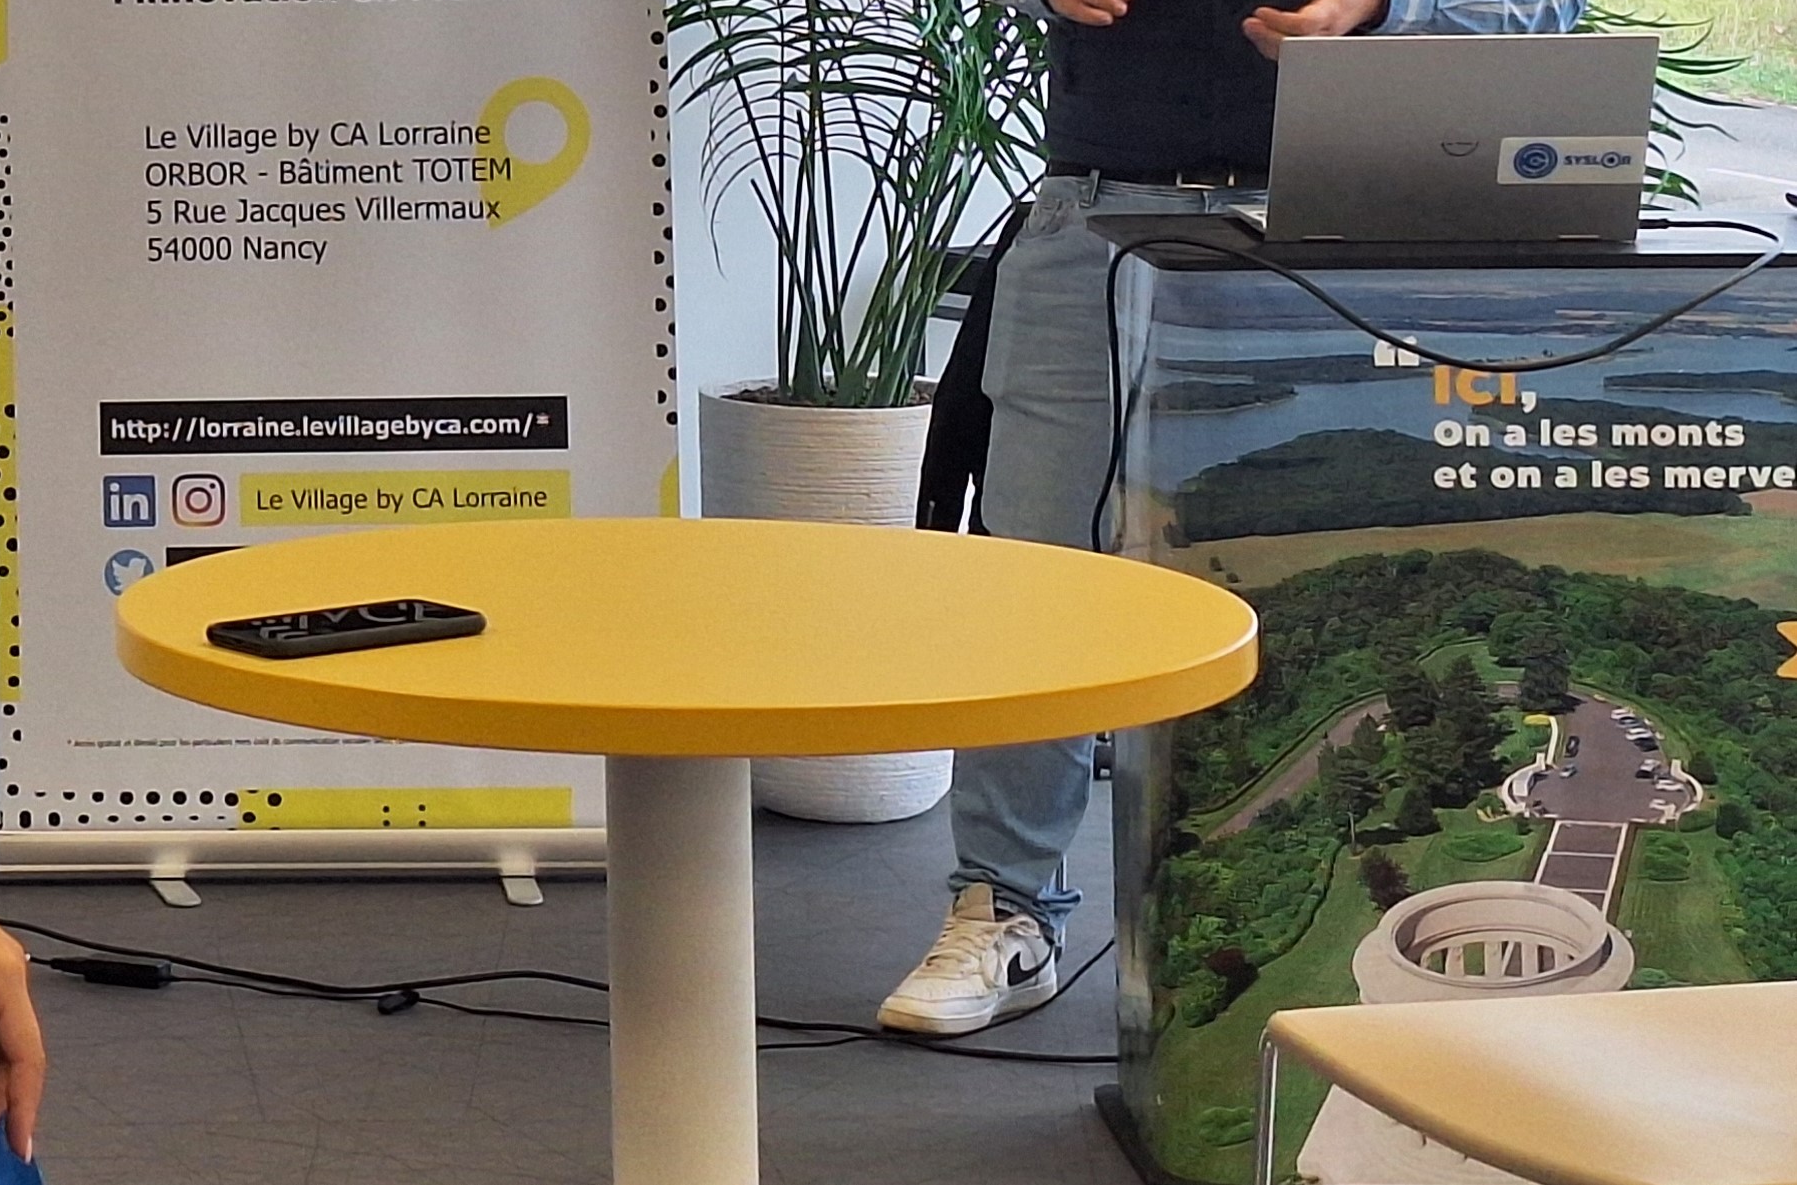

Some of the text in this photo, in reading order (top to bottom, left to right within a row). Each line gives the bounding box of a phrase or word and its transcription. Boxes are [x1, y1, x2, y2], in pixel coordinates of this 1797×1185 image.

[145, 120, 491, 154] Le Village by CA Lorraine
[145, 161, 249, 187] ORBOR
[279, 159, 403, 185] Bâtiment
[412, 157, 513, 183] TOTEM
[1563, 151, 1632, 169] SYSLOR
[147, 195, 502, 228] 5 Rue Jacques Villermaux
[148, 235, 329, 266] 54000 Nancy
[1433, 418, 1746, 448] On a les monts
[1433, 459, 1797, 489] et on a les merve
[256, 489, 284, 510] Le
[291, 487, 369, 514] Village
[376, 486, 404, 513] by
[412, 487, 445, 509] CA
[454, 485, 548, 508] Lorraine
